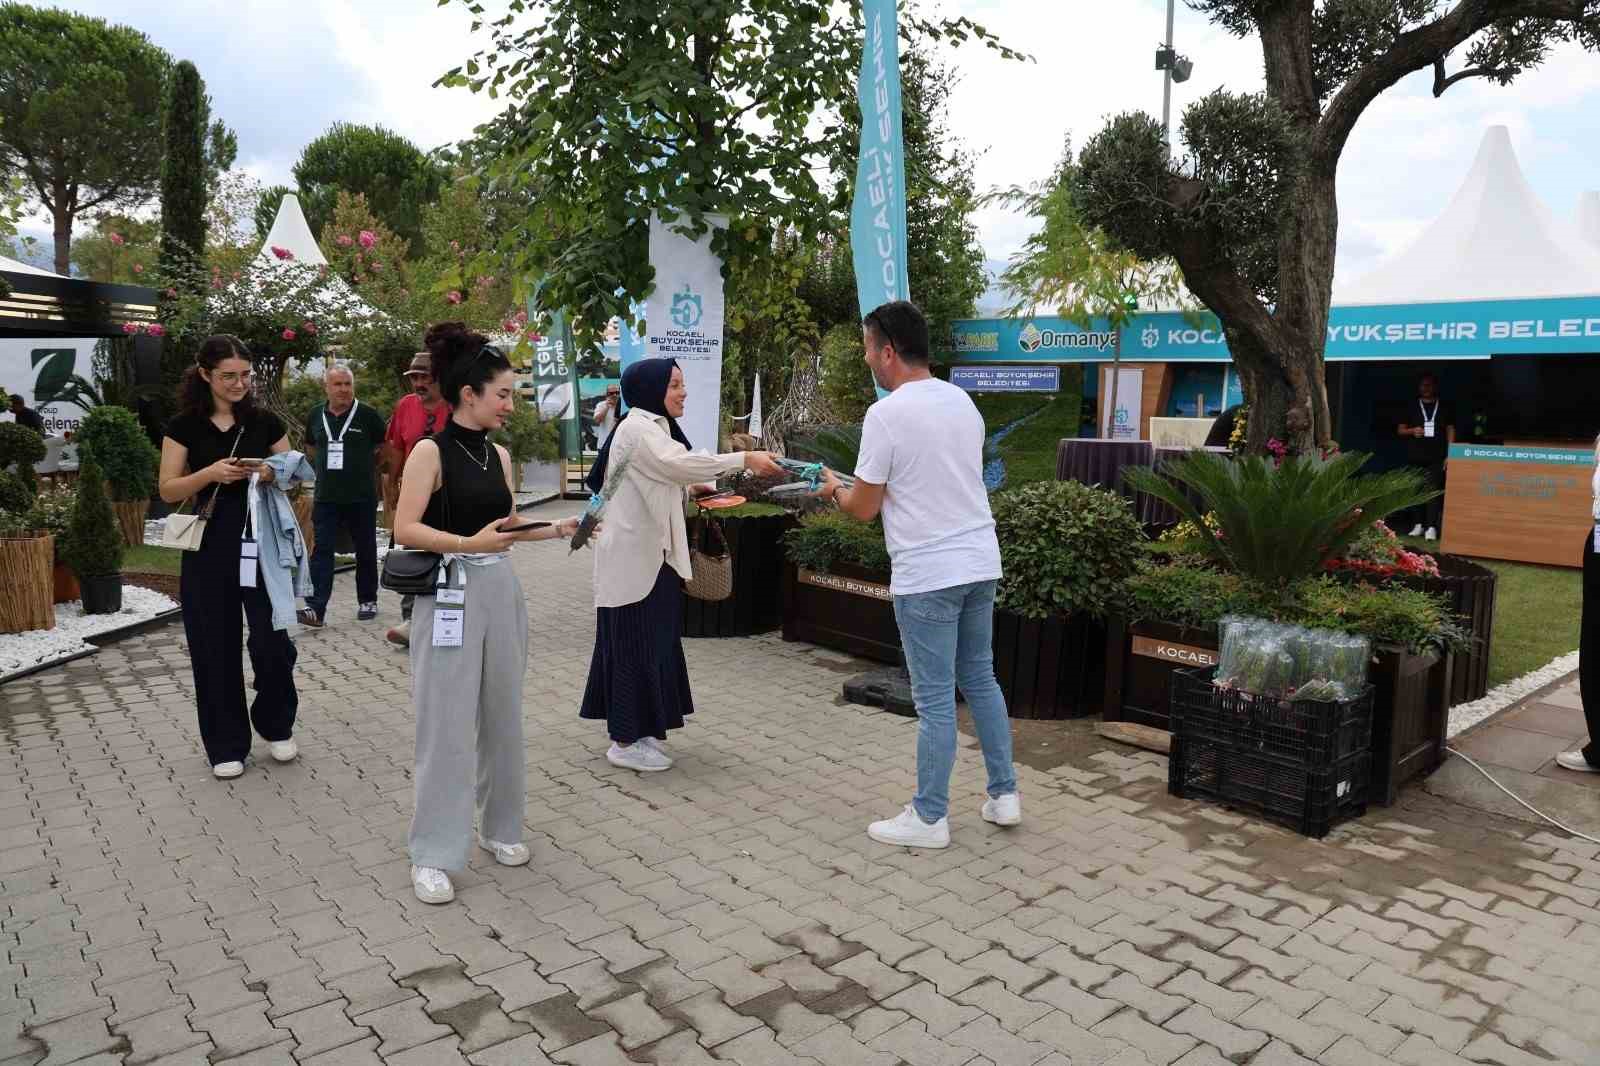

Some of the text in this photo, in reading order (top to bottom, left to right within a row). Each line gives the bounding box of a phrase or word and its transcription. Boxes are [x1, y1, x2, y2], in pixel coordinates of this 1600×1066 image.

[1041, 330, 1119, 351] Ormanya
[1168, 318, 1600, 345] KOCA YÜKŞEHİR BELED
[44, 416, 80, 430] elena
[1157, 645, 1216, 665] KOCAEL
